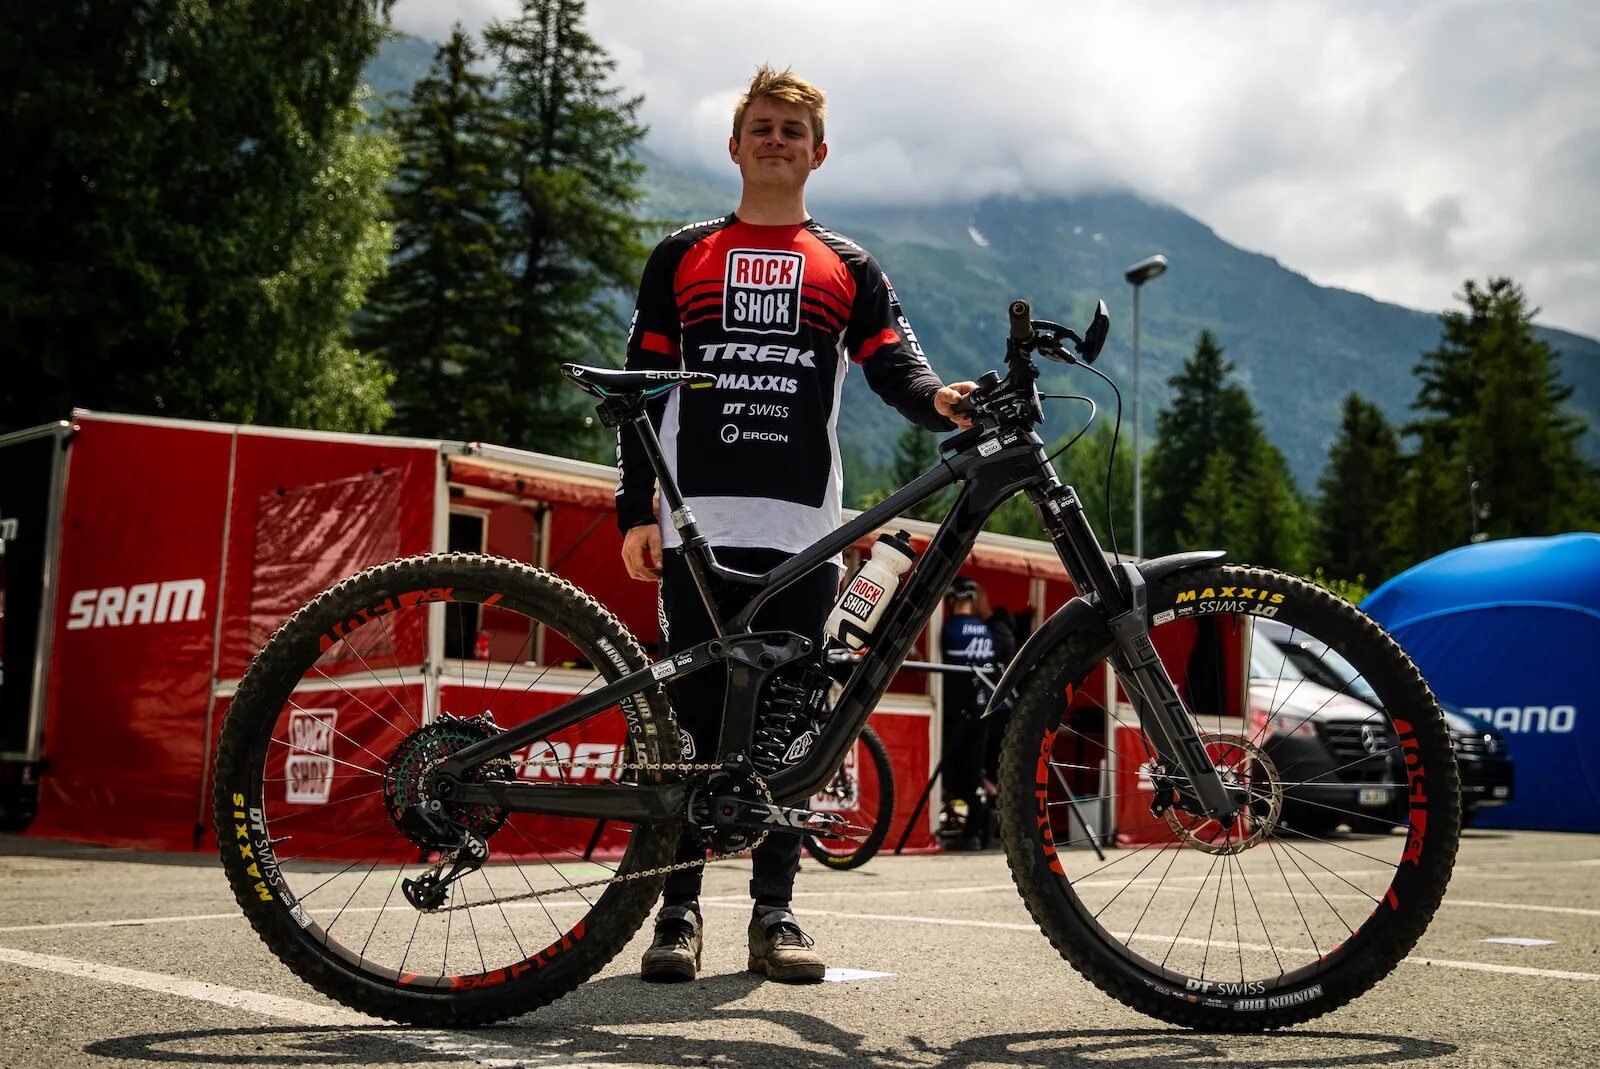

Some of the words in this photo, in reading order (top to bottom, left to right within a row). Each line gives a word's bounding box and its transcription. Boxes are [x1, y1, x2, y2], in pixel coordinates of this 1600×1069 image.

[736, 258, 794, 285] ROCK
[734, 291, 790, 324] SHOX
[699, 343, 816, 368] TREK
[715, 374, 798, 394] MAXXIS
[722, 403, 746, 415] DT
[748, 404, 789, 418] SWISS
[742, 432, 788, 443] ERGON
[853, 579, 881, 603] ROCK
[1175, 586, 1285, 604] MAXXIS
[66, 578, 205, 630] SRAM
[844, 595, 872, 618] SHOX
[1198, 600, 1247, 614] SWISS
[1250, 603, 1279, 618] DT
[620, 696, 642, 734] SWIS
[249, 807, 265, 835] DT
[233, 792, 273, 901] MAXXIS
[255, 839, 283, 887] SWISS
[1185, 978, 1213, 993] DT
[1217, 981, 1266, 996] SWISS
[1269, 984, 1324, 1010] MINION
[1233, 998, 1267, 1012] DHF
